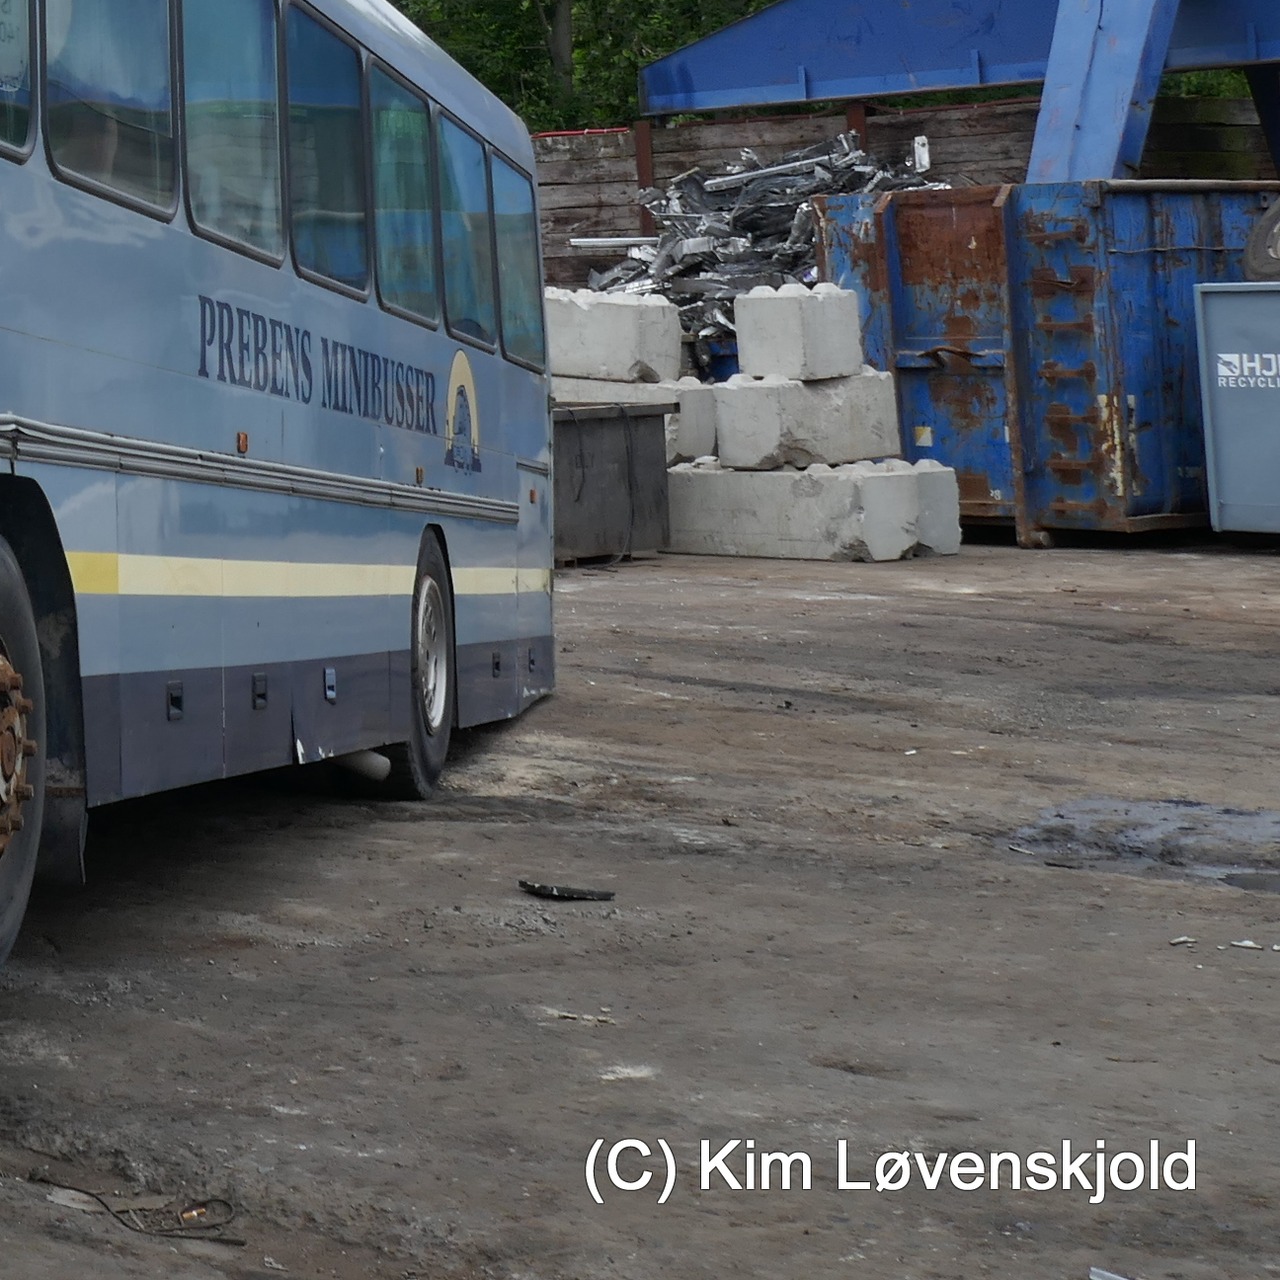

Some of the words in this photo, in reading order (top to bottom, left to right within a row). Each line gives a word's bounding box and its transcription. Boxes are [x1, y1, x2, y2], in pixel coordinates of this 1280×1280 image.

[197, 294, 313, 405] PREBENS
[320, 336, 438, 435] MINIBUSSER
[1242, 353, 1280, 376] HJ
